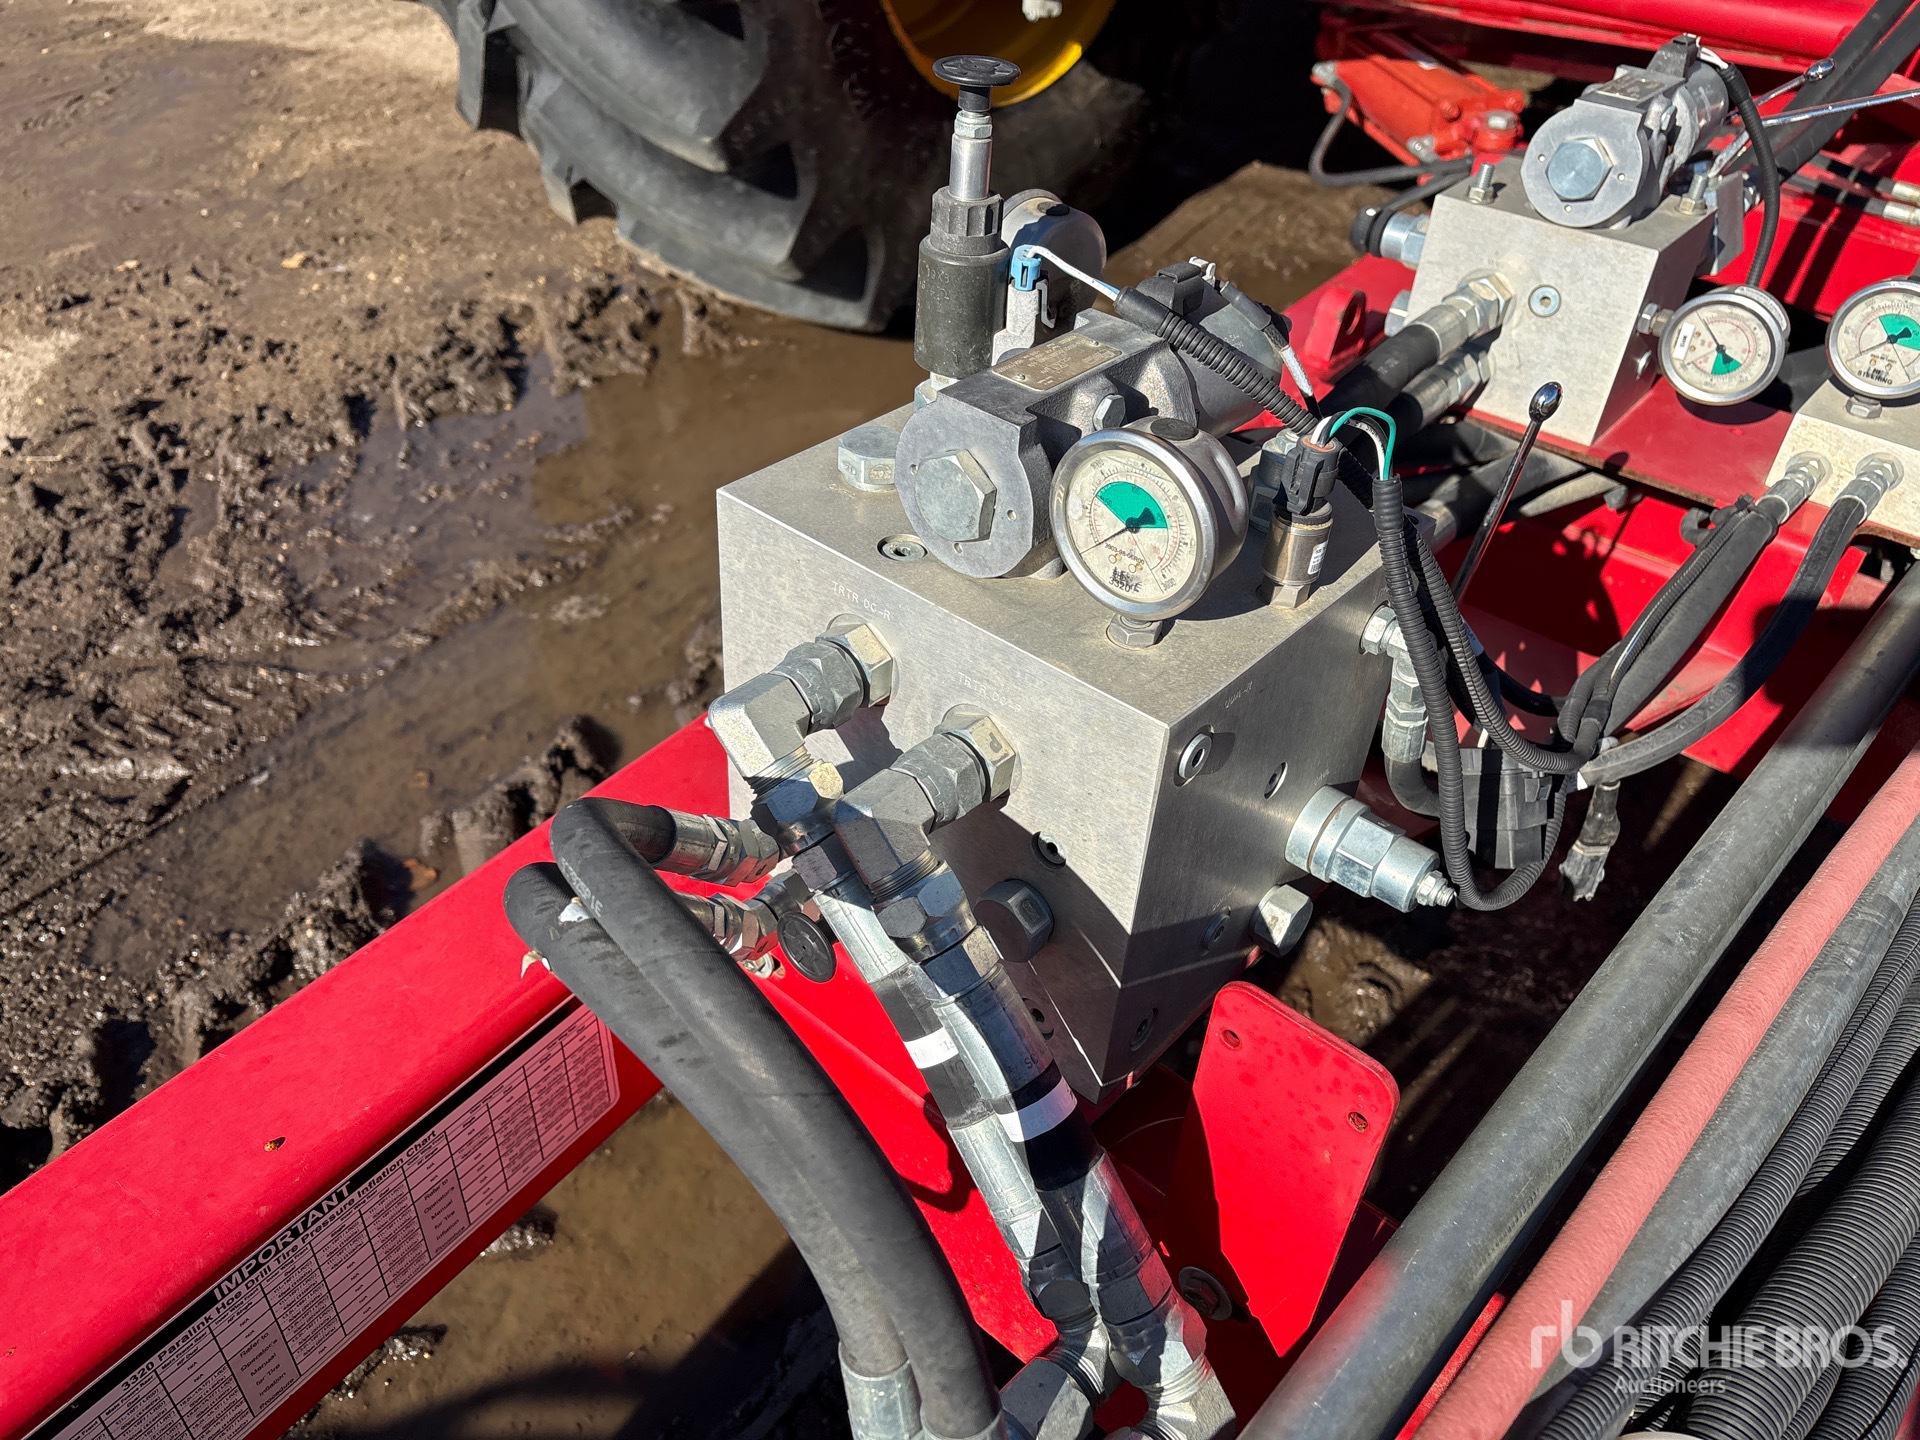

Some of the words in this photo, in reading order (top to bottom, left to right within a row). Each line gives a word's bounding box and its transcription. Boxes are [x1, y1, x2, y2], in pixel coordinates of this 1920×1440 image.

[831, 580, 859, 604] TRTR
[213, 1180, 353, 1301] IMPORTANT
[120, 1359, 155, 1391] 3320
[157, 1312, 213, 1362] Paralink
[215, 1288, 242, 1314] Hoe
[244, 1264, 271, 1290] Drill
[274, 1242, 298, 1266] Tire
[300, 1196, 355, 1244] Pressure
[357, 1155, 403, 1198] Inflation
[405, 1128, 436, 1158] Chart
[239, 1337, 260, 1358] Refer
[261, 1331, 268, 1340] to
[250, 1351, 276, 1377] Manual
[255, 1374, 266, 1386] for
[266, 1362, 280, 1377] Tire
[258, 1370, 286, 1397] Inflation
[259, 1376, 294, 1410] Procedure
